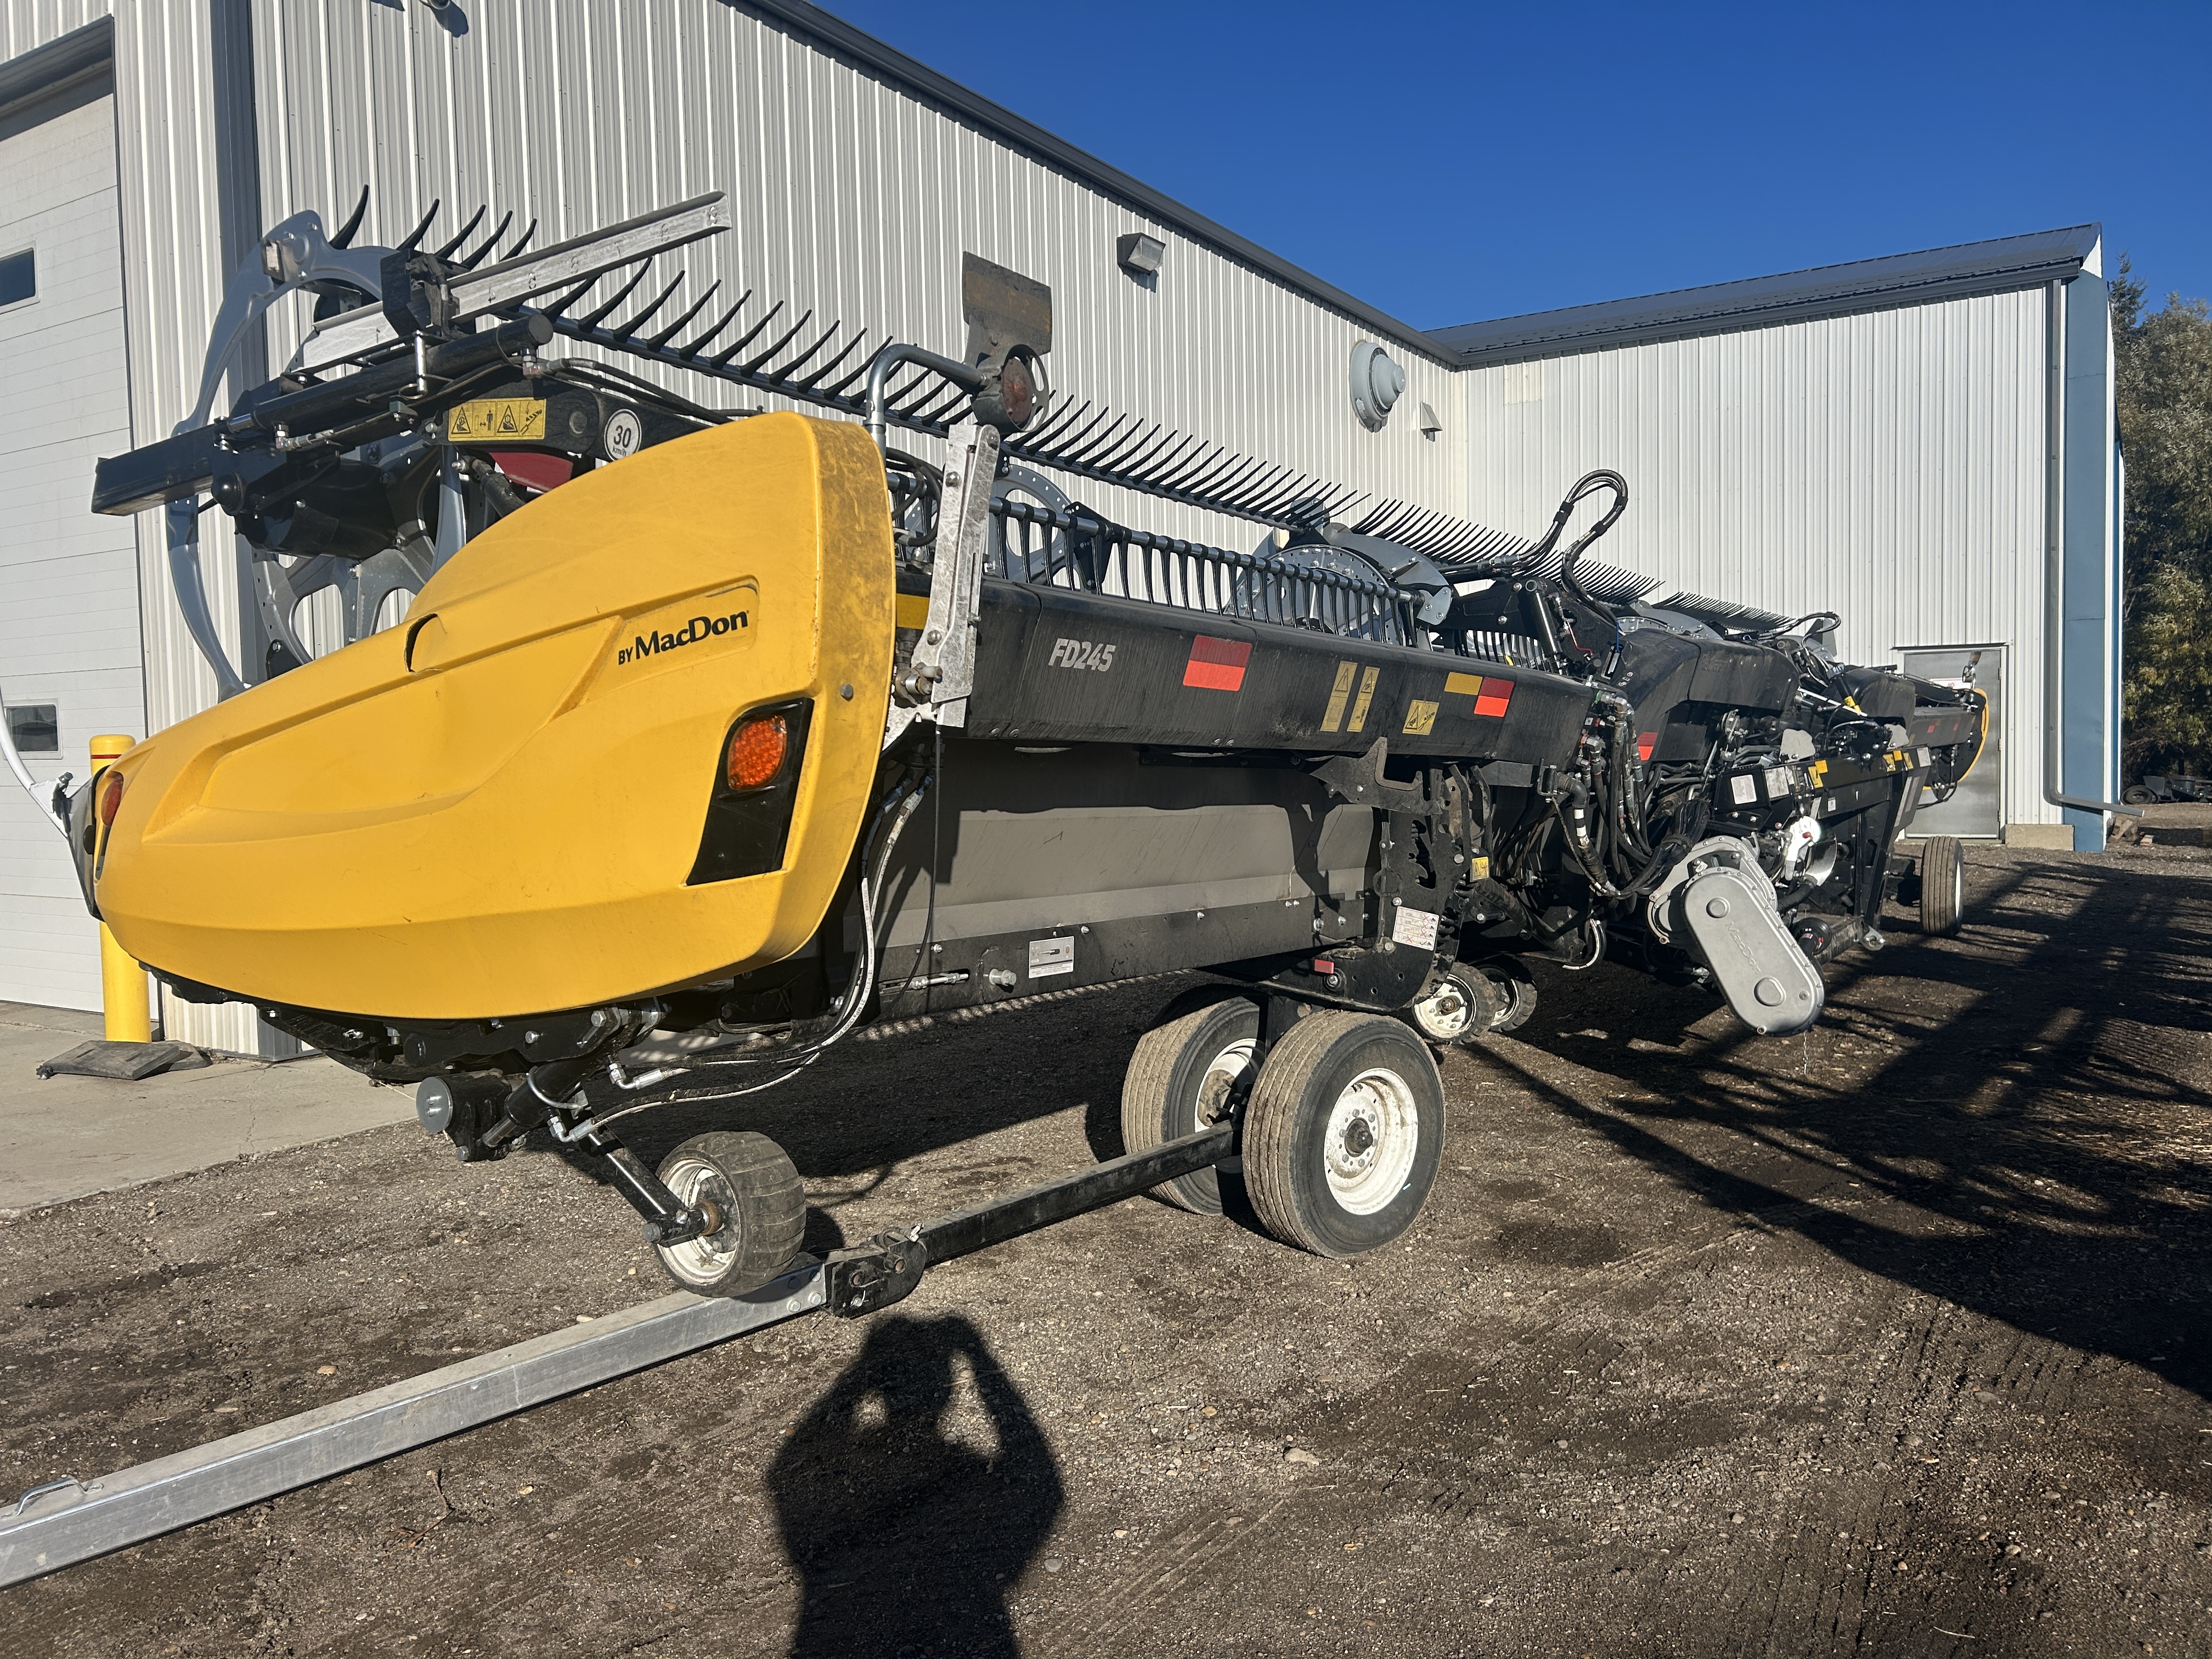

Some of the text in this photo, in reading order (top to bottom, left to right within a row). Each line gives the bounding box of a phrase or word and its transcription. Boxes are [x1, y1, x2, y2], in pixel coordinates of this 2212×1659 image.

[613, 425, 631, 448] 30
[618, 611, 748, 665] BY MacDon
[1048, 637, 1116, 672] FD245
[1726, 922, 1761, 974] MacDon
